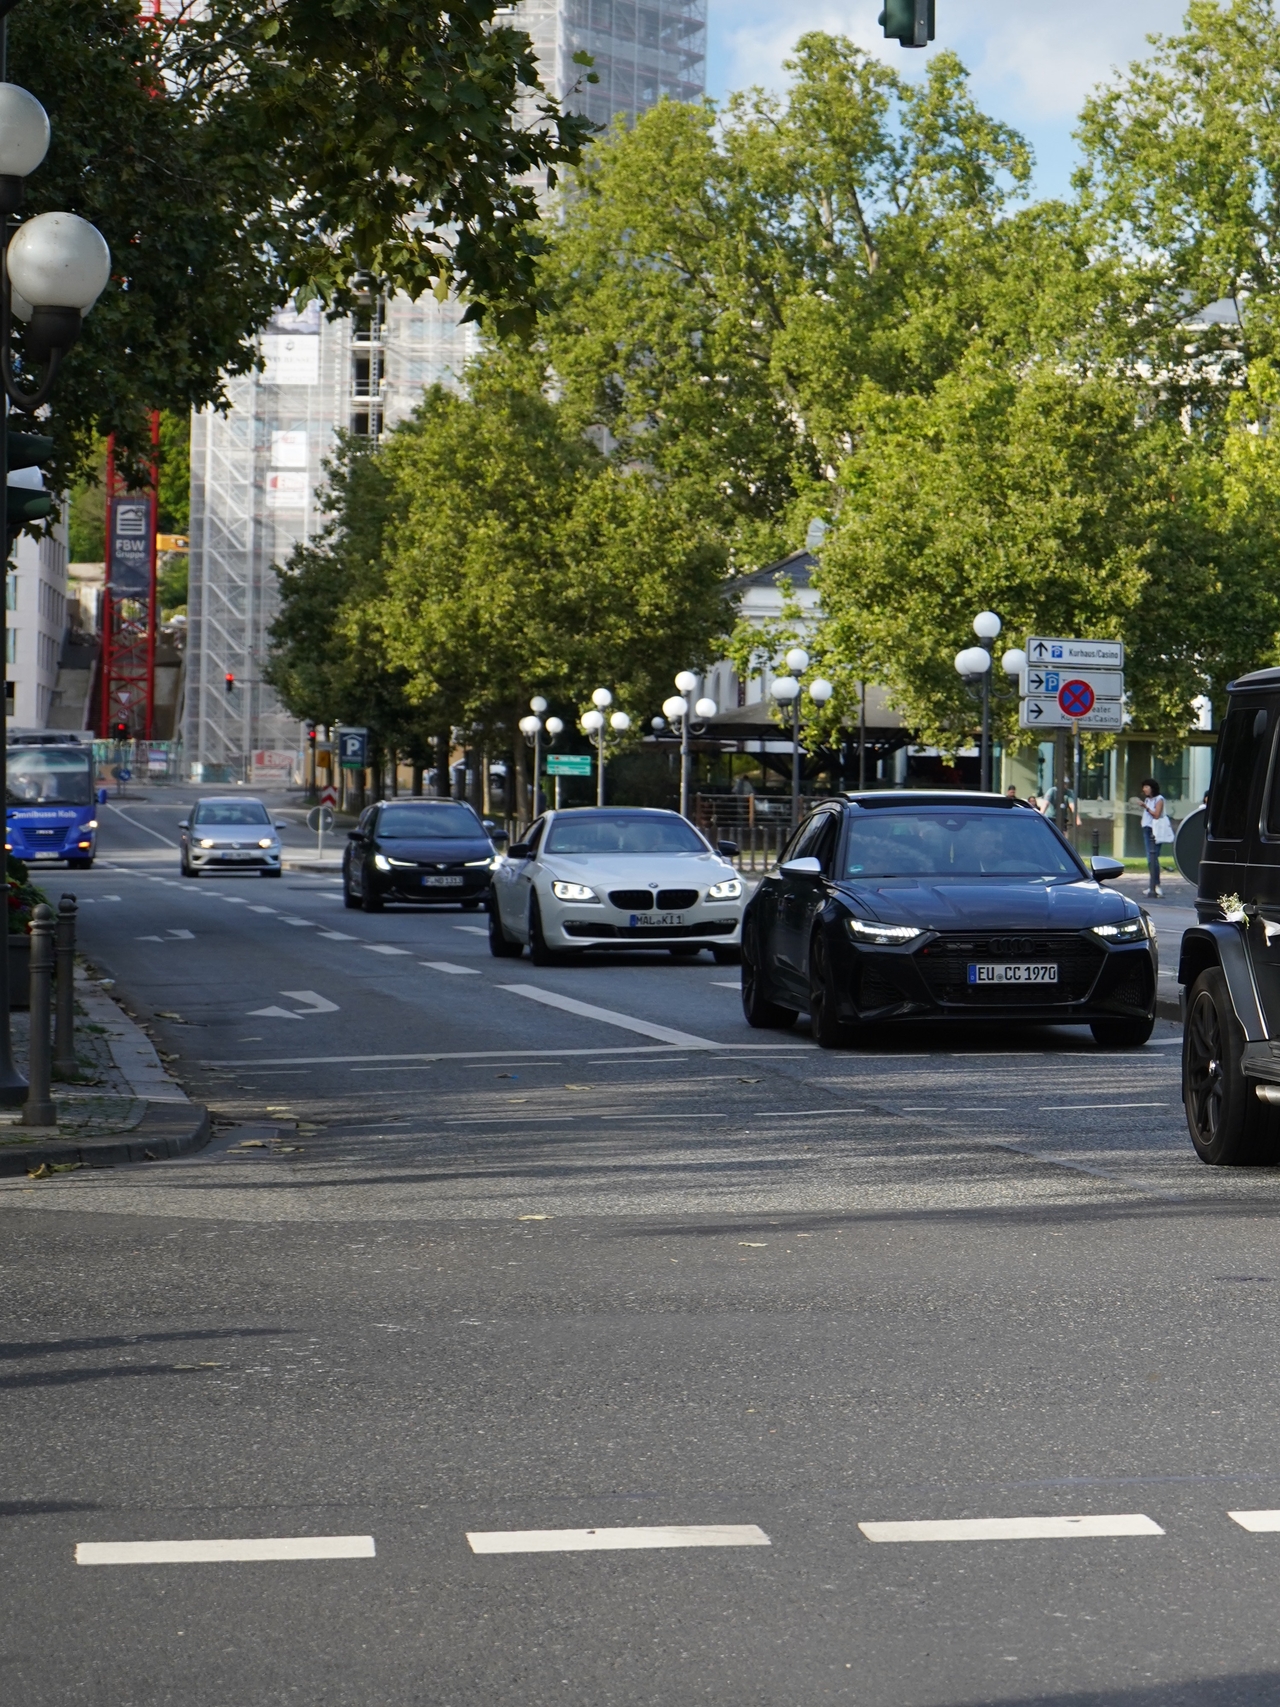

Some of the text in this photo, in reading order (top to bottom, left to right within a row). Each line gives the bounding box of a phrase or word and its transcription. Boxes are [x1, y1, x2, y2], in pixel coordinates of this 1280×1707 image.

[116, 539, 145, 551] FBW
[116, 550, 146, 559] Gruppe
[1068, 648, 1118, 659] Kurhaus/Casino
[58, 810, 77, 818] Kolb
[636, 915, 656, 925] MAL
[978, 966, 1057, 981] EU CC 1970
